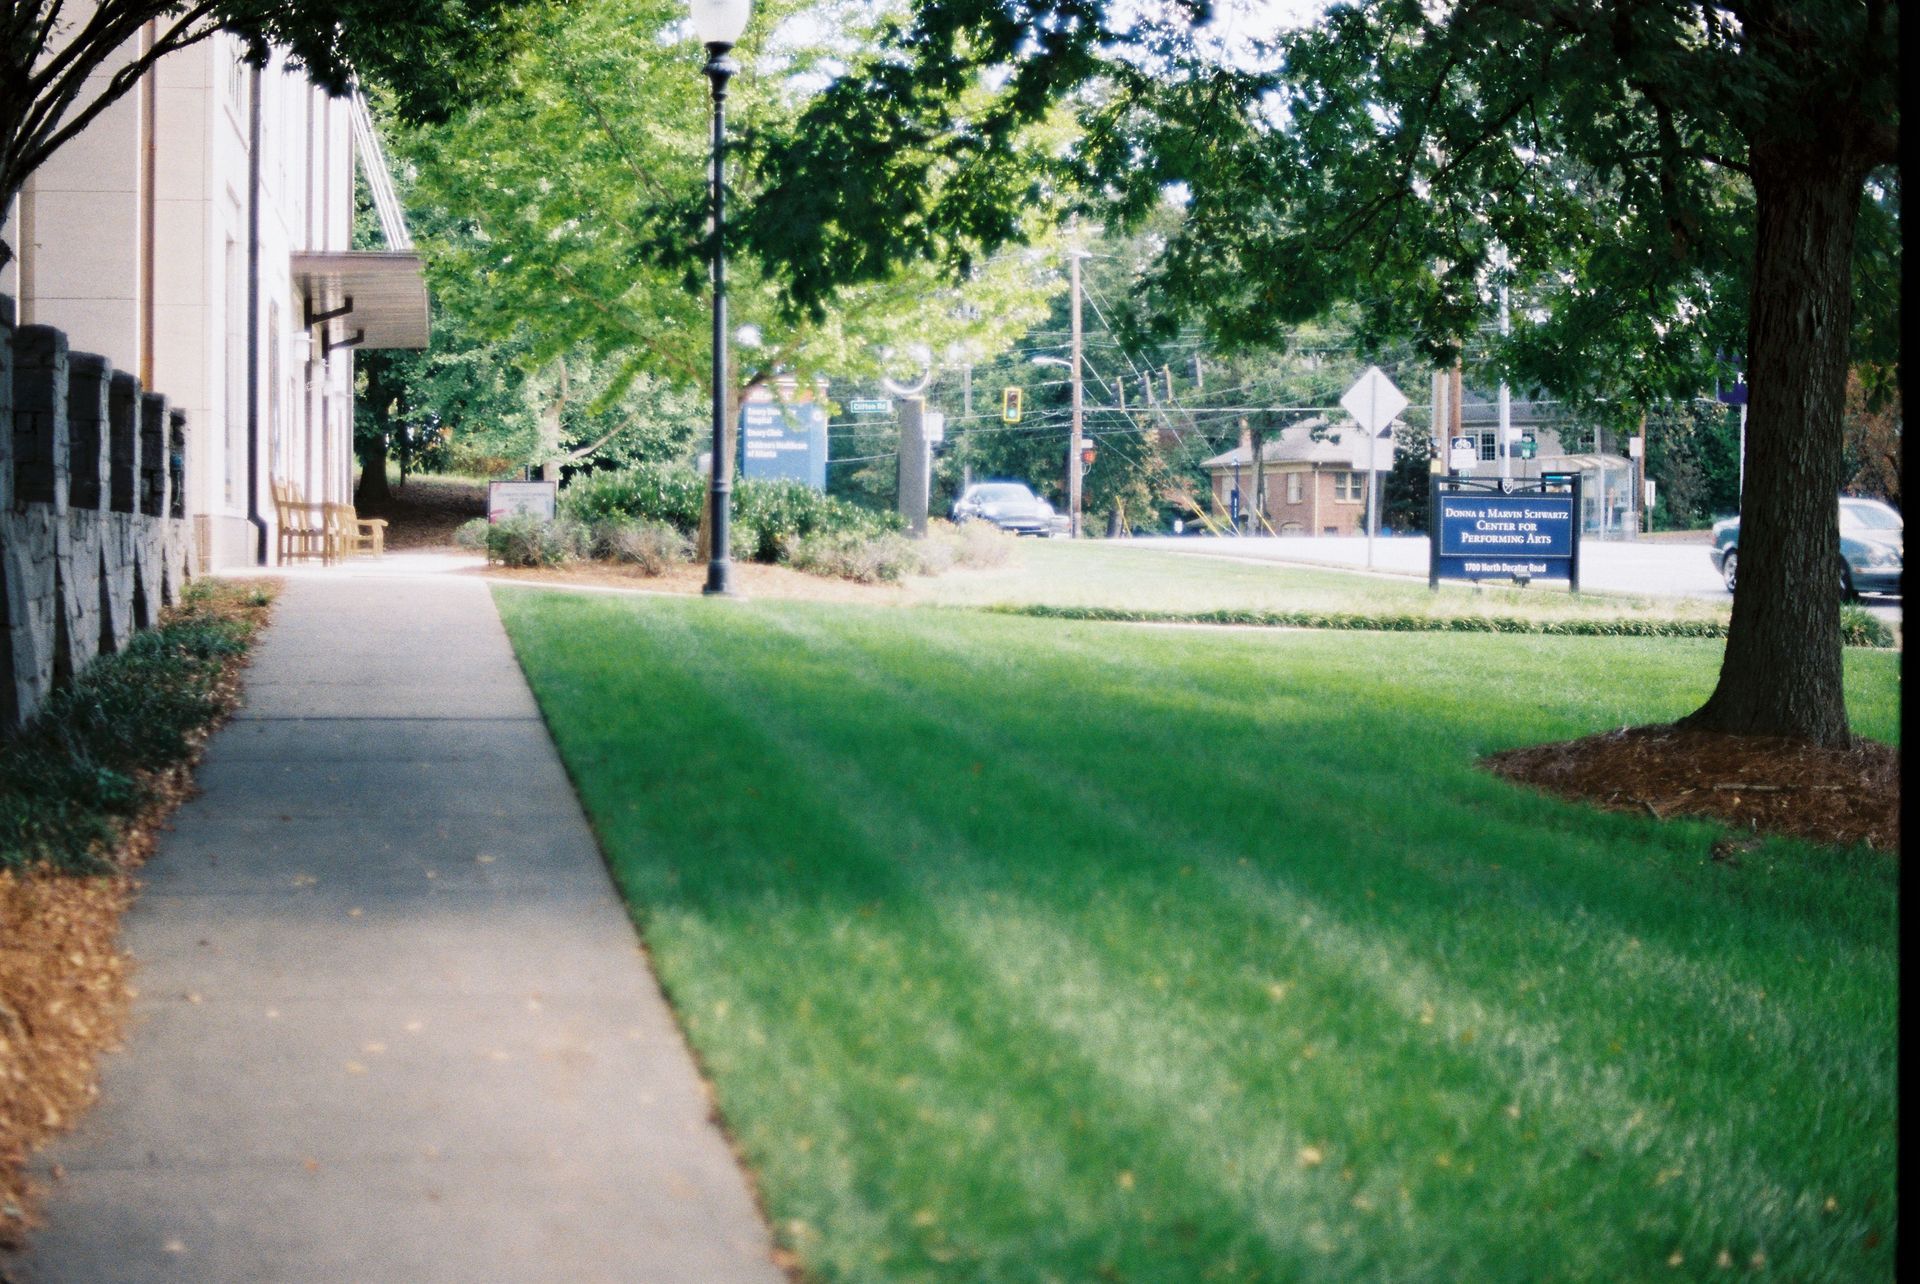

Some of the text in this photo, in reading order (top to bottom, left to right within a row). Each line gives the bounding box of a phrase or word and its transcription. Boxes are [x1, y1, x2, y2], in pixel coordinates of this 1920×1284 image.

[1445, 508, 1476, 518] DONNA
[1487, 508, 1522, 519] MARVIN
[1524, 509, 1568, 519] SCHWARTZ
[1476, 520, 1537, 531] CENTER FOR
[1461, 532, 1552, 544] PERFORMING ARTS
[1481, 563, 1501, 572] North
[1502, 563, 1528, 572] Decatur
[1529, 564, 1546, 573] Road
